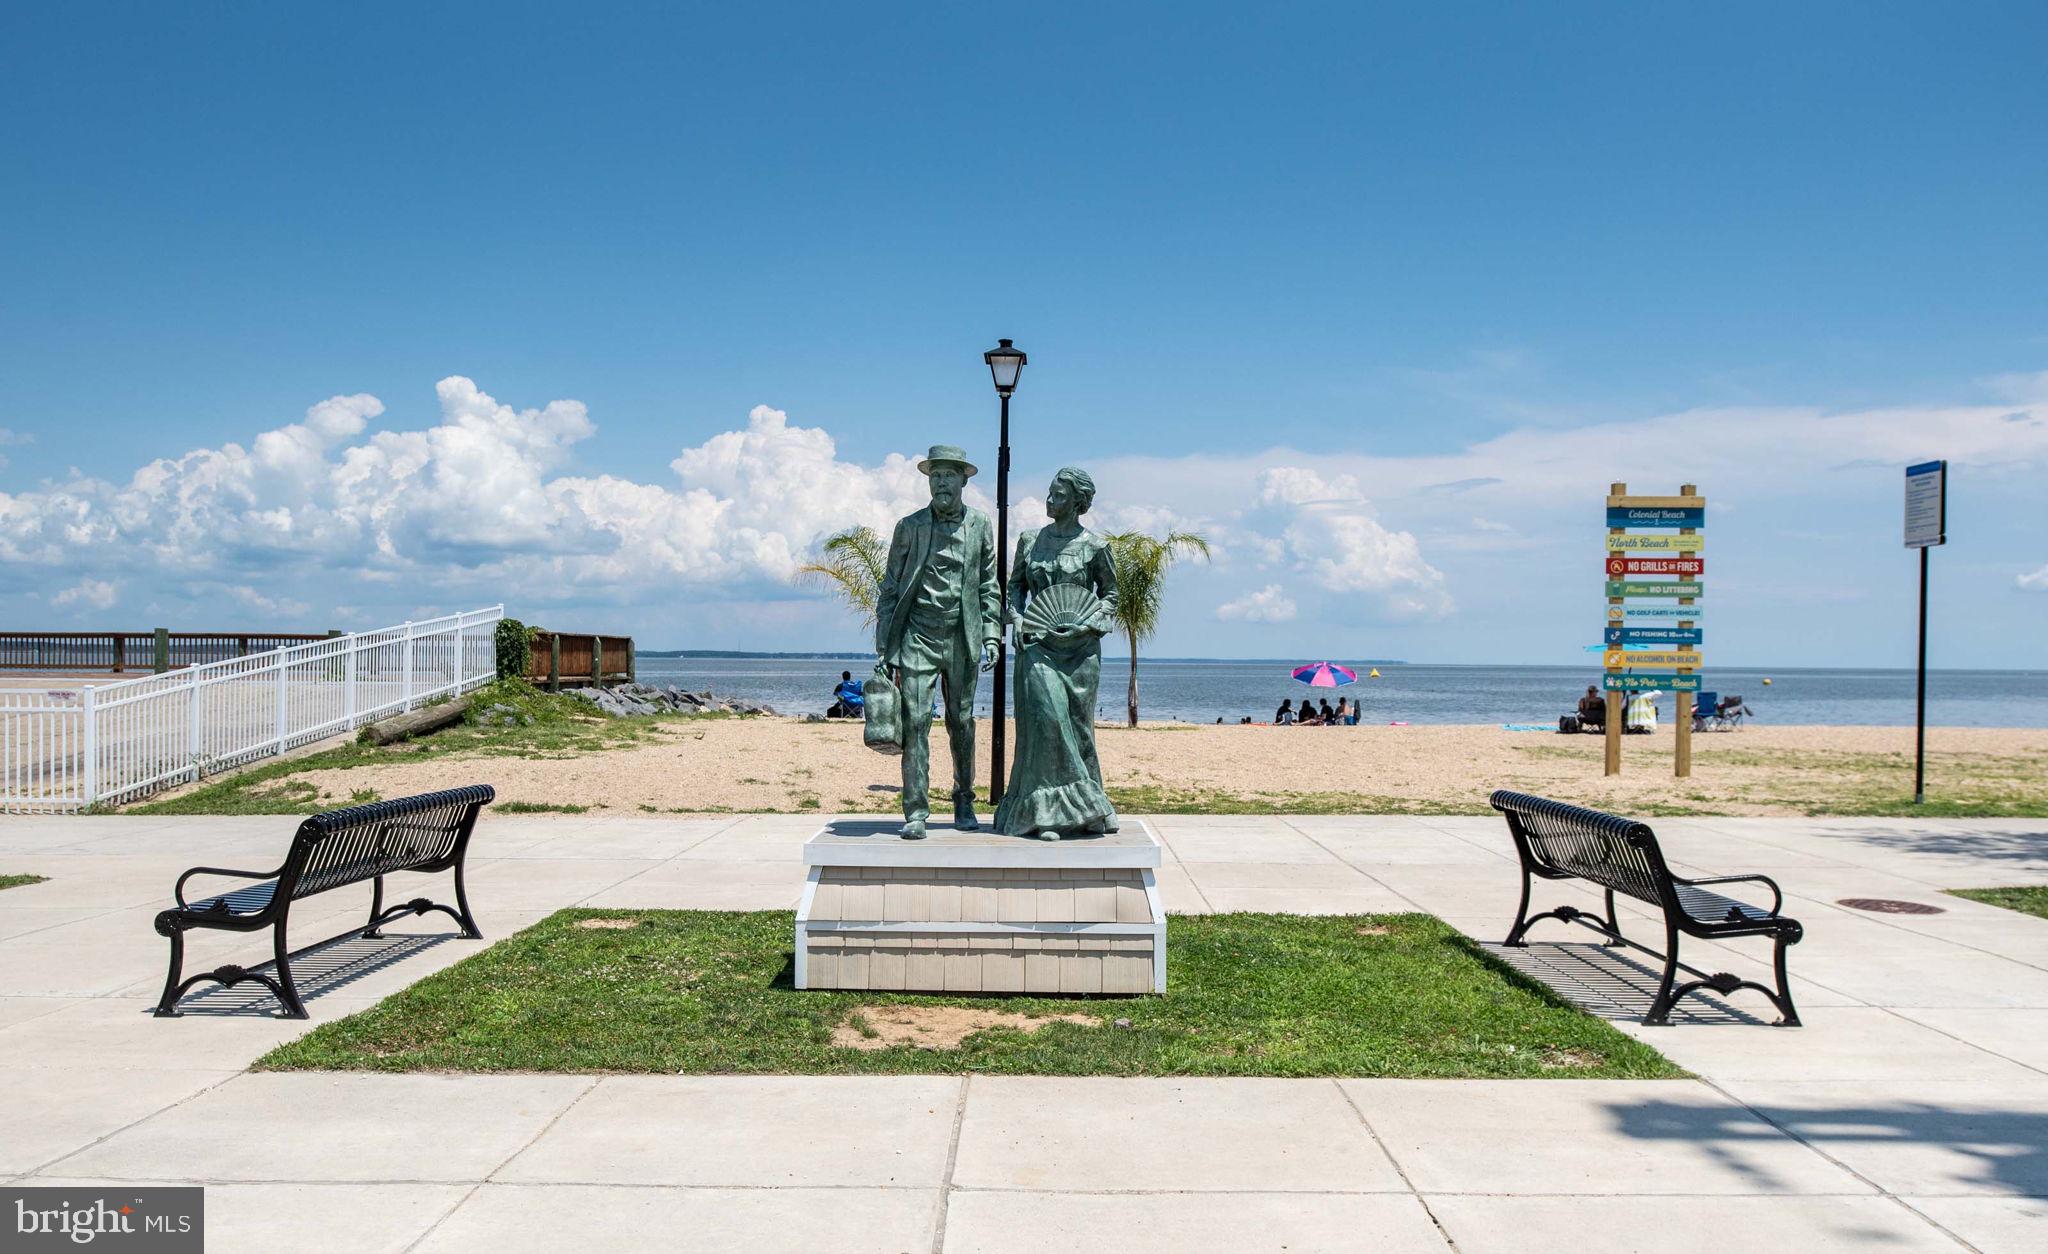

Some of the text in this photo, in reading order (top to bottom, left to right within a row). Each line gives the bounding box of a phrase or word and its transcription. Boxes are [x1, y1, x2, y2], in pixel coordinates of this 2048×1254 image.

[1629, 509, 1685, 518] Colonial Beach
[1609, 537, 1638, 548] North
[1640, 537, 1669, 548] Beach
[1628, 561, 1639, 571] NO
[1640, 561, 1667, 571] GRILLS
[1677, 562, 1699, 571] FIRES
[1625, 677, 1638, 687] No
[1640, 678, 1658, 686] Pets
[1672, 678, 1697, 687] Beach
